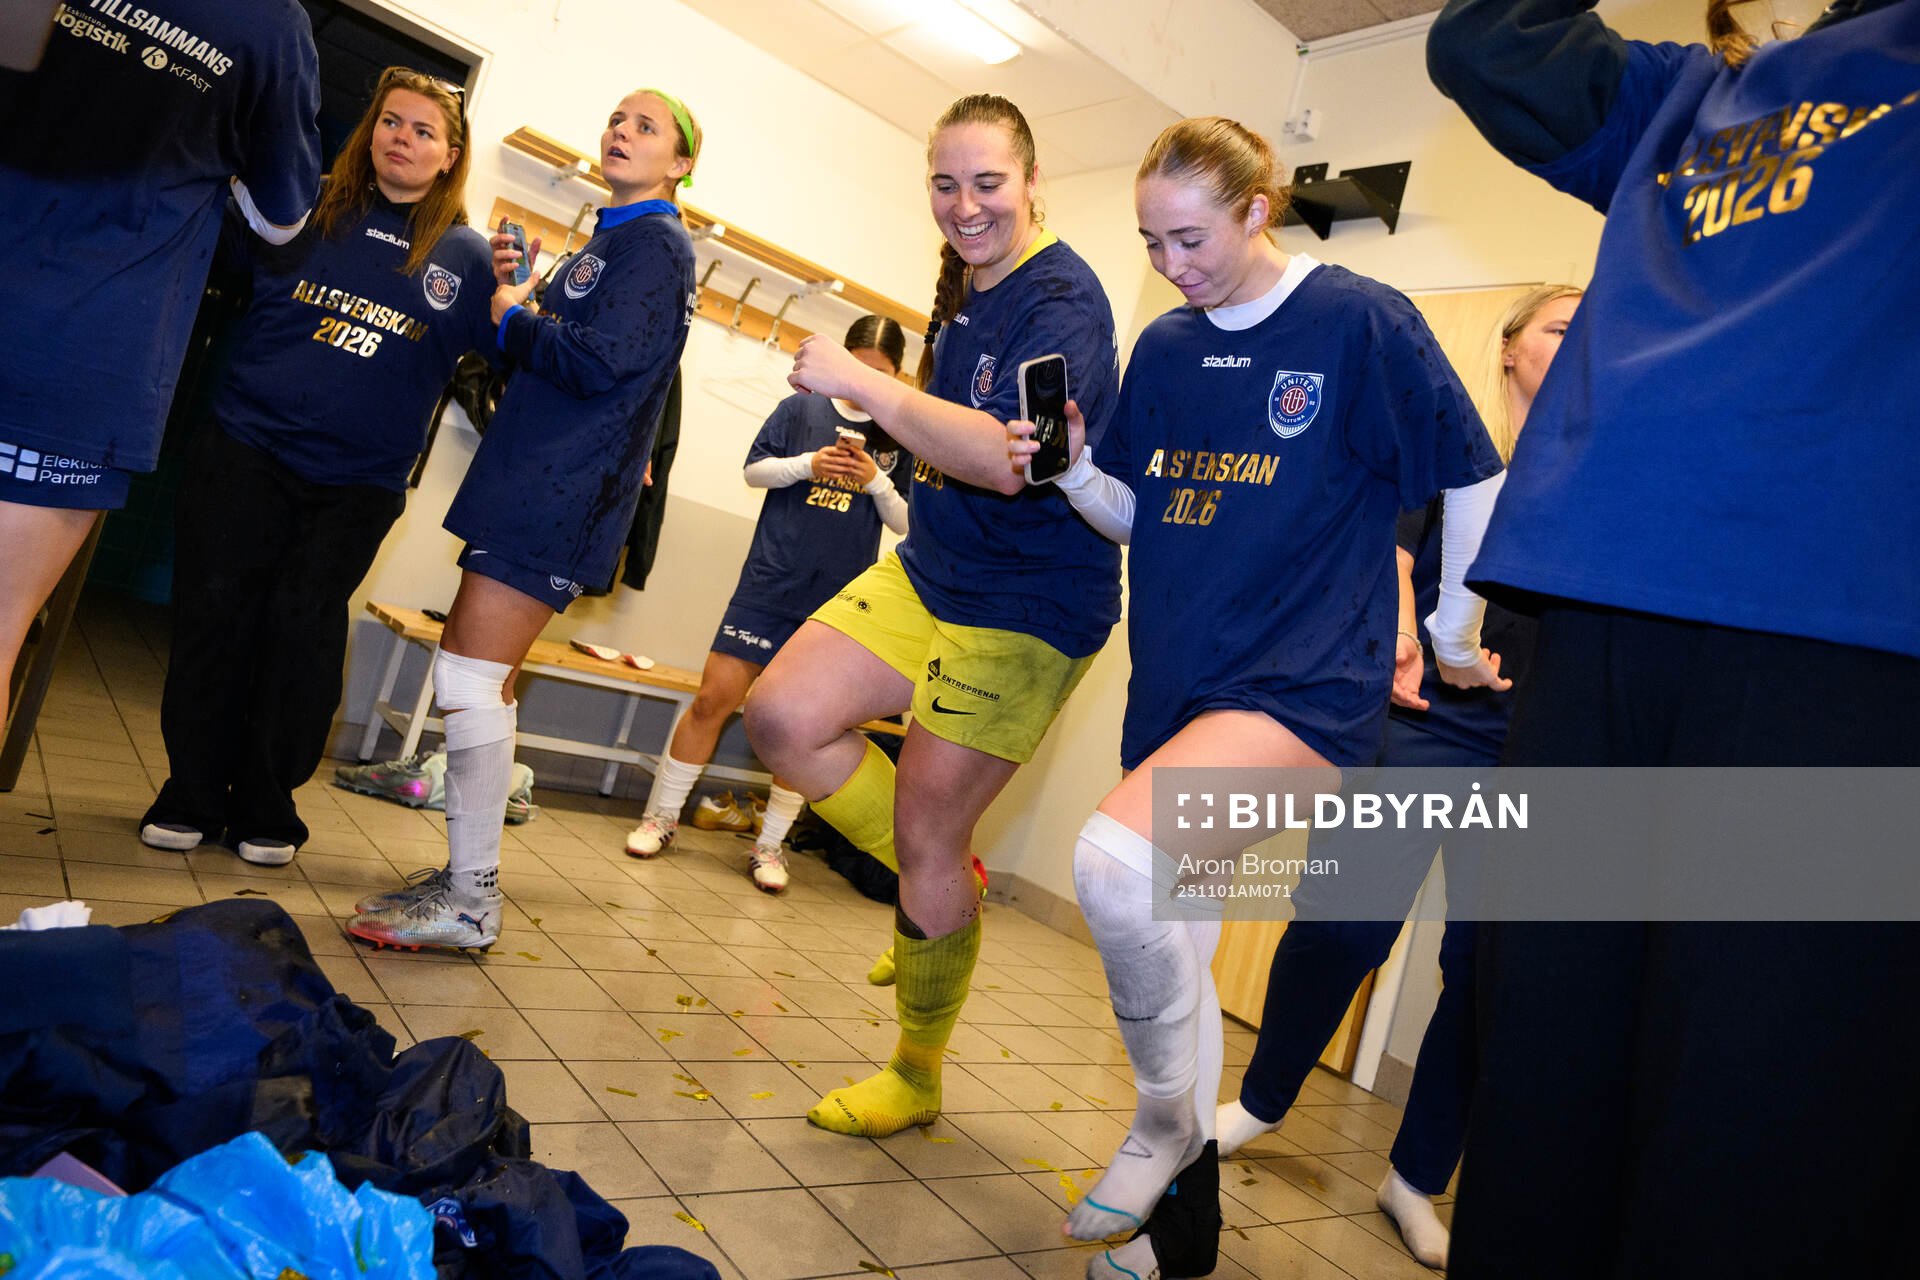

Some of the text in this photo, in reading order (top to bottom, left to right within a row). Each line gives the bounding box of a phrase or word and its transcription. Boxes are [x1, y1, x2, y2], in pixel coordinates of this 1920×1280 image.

[54, 3, 131, 54] logistik
[169, 63, 213, 93] KFAST
[1683, 146, 1825, 247] 2026
[365, 227, 410, 250] stadium
[290, 279, 429, 342] ALLSVENSKAN
[312, 316, 383, 358] 2026
[1201, 354, 1252, 368] stadium
[1280, 377, 1314, 392] UNITED
[39, 470, 101, 485] Partner
[805, 486, 853, 513] 2026
[1161, 487, 1223, 526] 2026
[941, 674, 1000, 701] ENTREPRENAD
